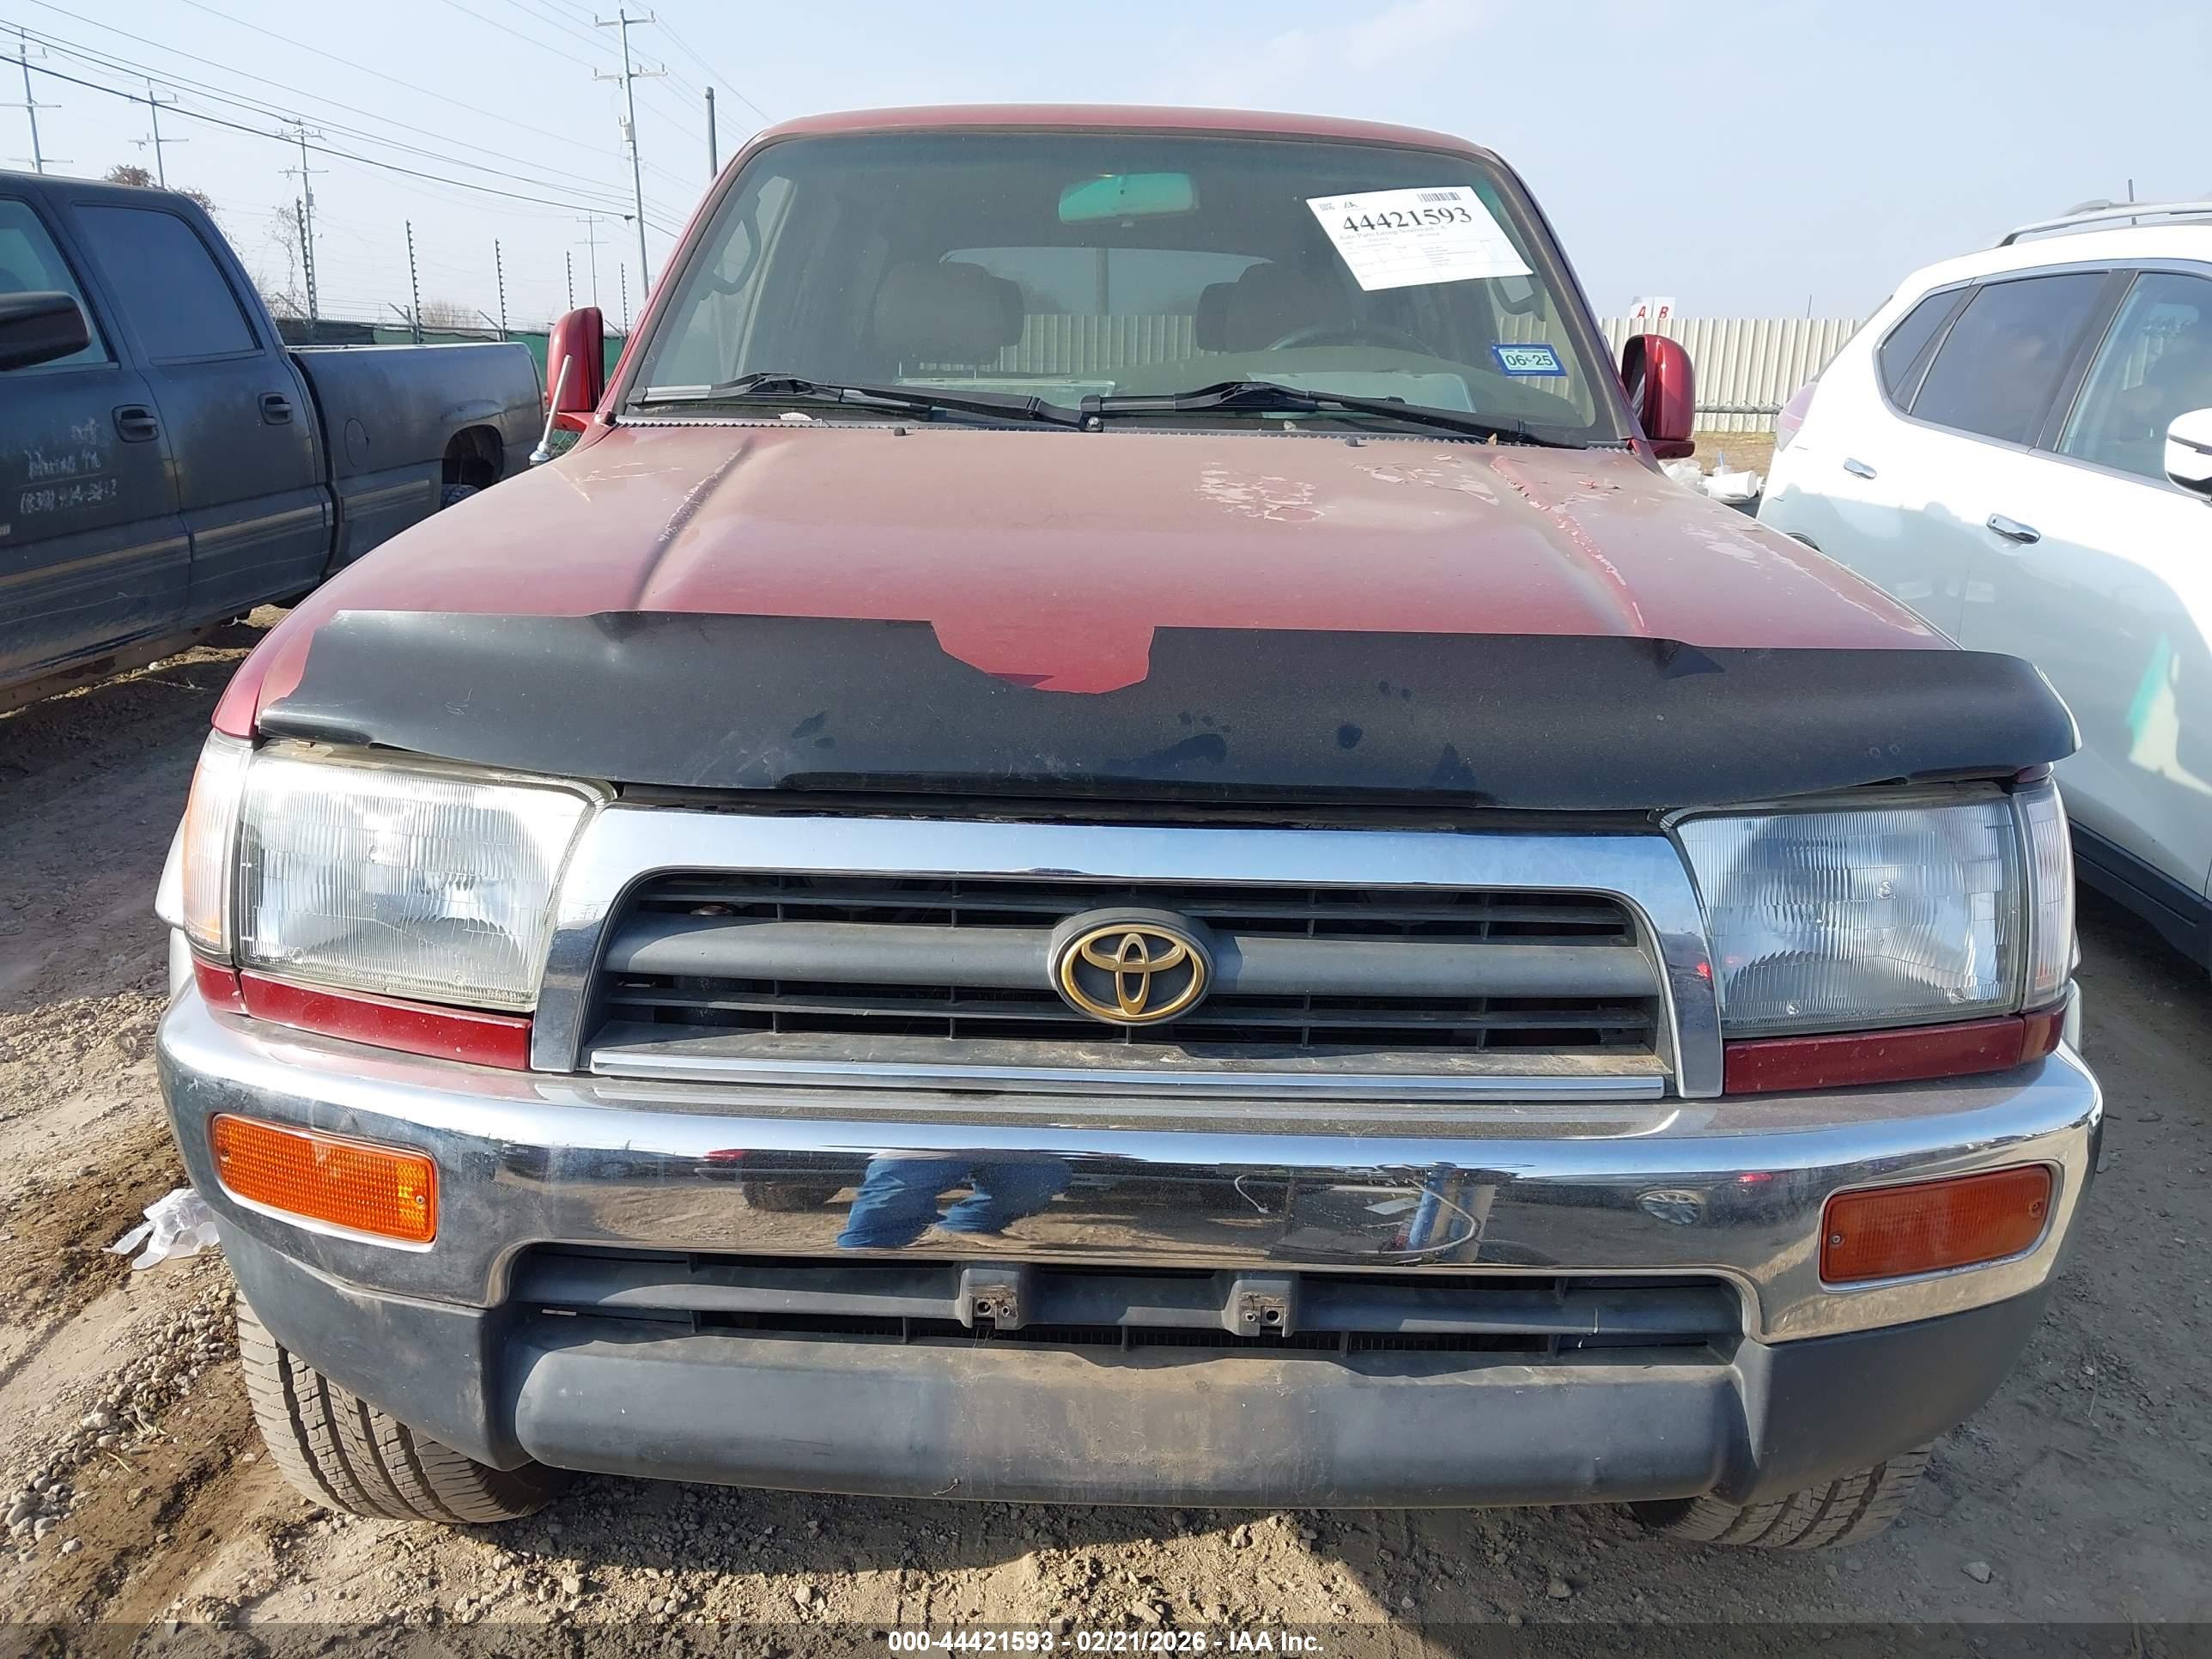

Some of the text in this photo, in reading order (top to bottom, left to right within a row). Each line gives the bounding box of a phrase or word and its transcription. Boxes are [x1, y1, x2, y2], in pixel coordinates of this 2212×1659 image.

[1343, 207, 1473, 232] 44421593
[1637, 305, 1646, 319] A
[1659, 306, 1668, 319] B
